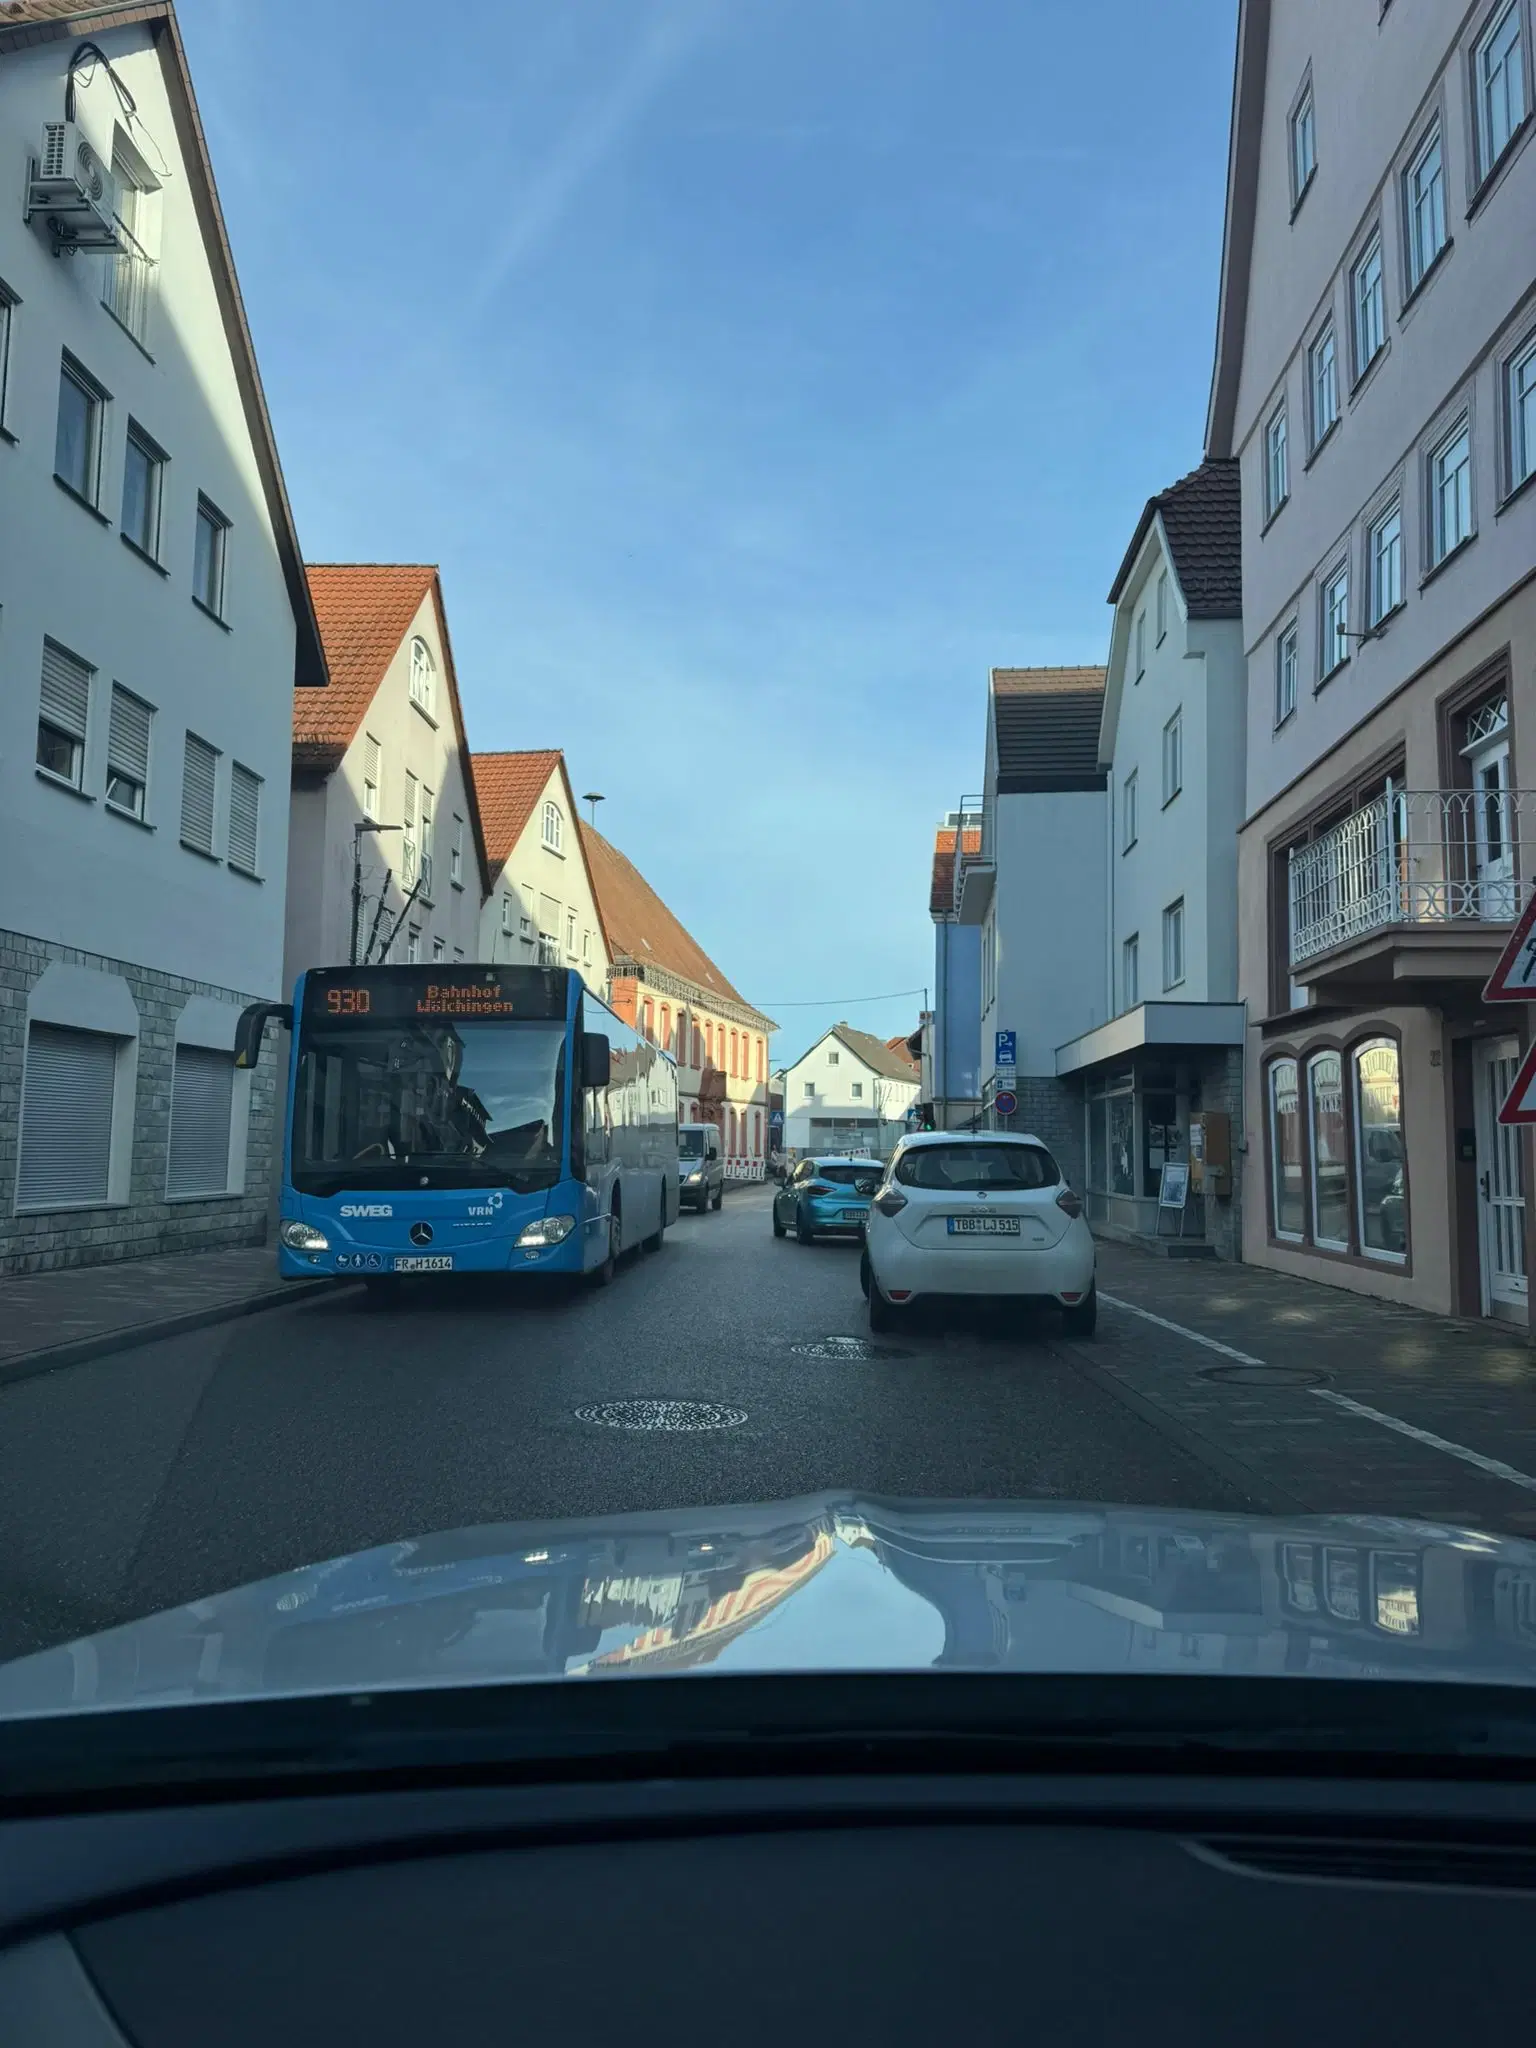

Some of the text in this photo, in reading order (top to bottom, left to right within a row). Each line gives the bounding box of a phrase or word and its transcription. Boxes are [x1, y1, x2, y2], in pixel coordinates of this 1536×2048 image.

[427, 985, 501, 999] Bahnhof
[327, 989, 370, 1013] 930
[416, 999, 514, 1014] Wölchingen
[998, 1033, 1008, 1047] P
[340, 1205, 393, 1217] SWEG
[468, 1206, 494, 1216] VRN
